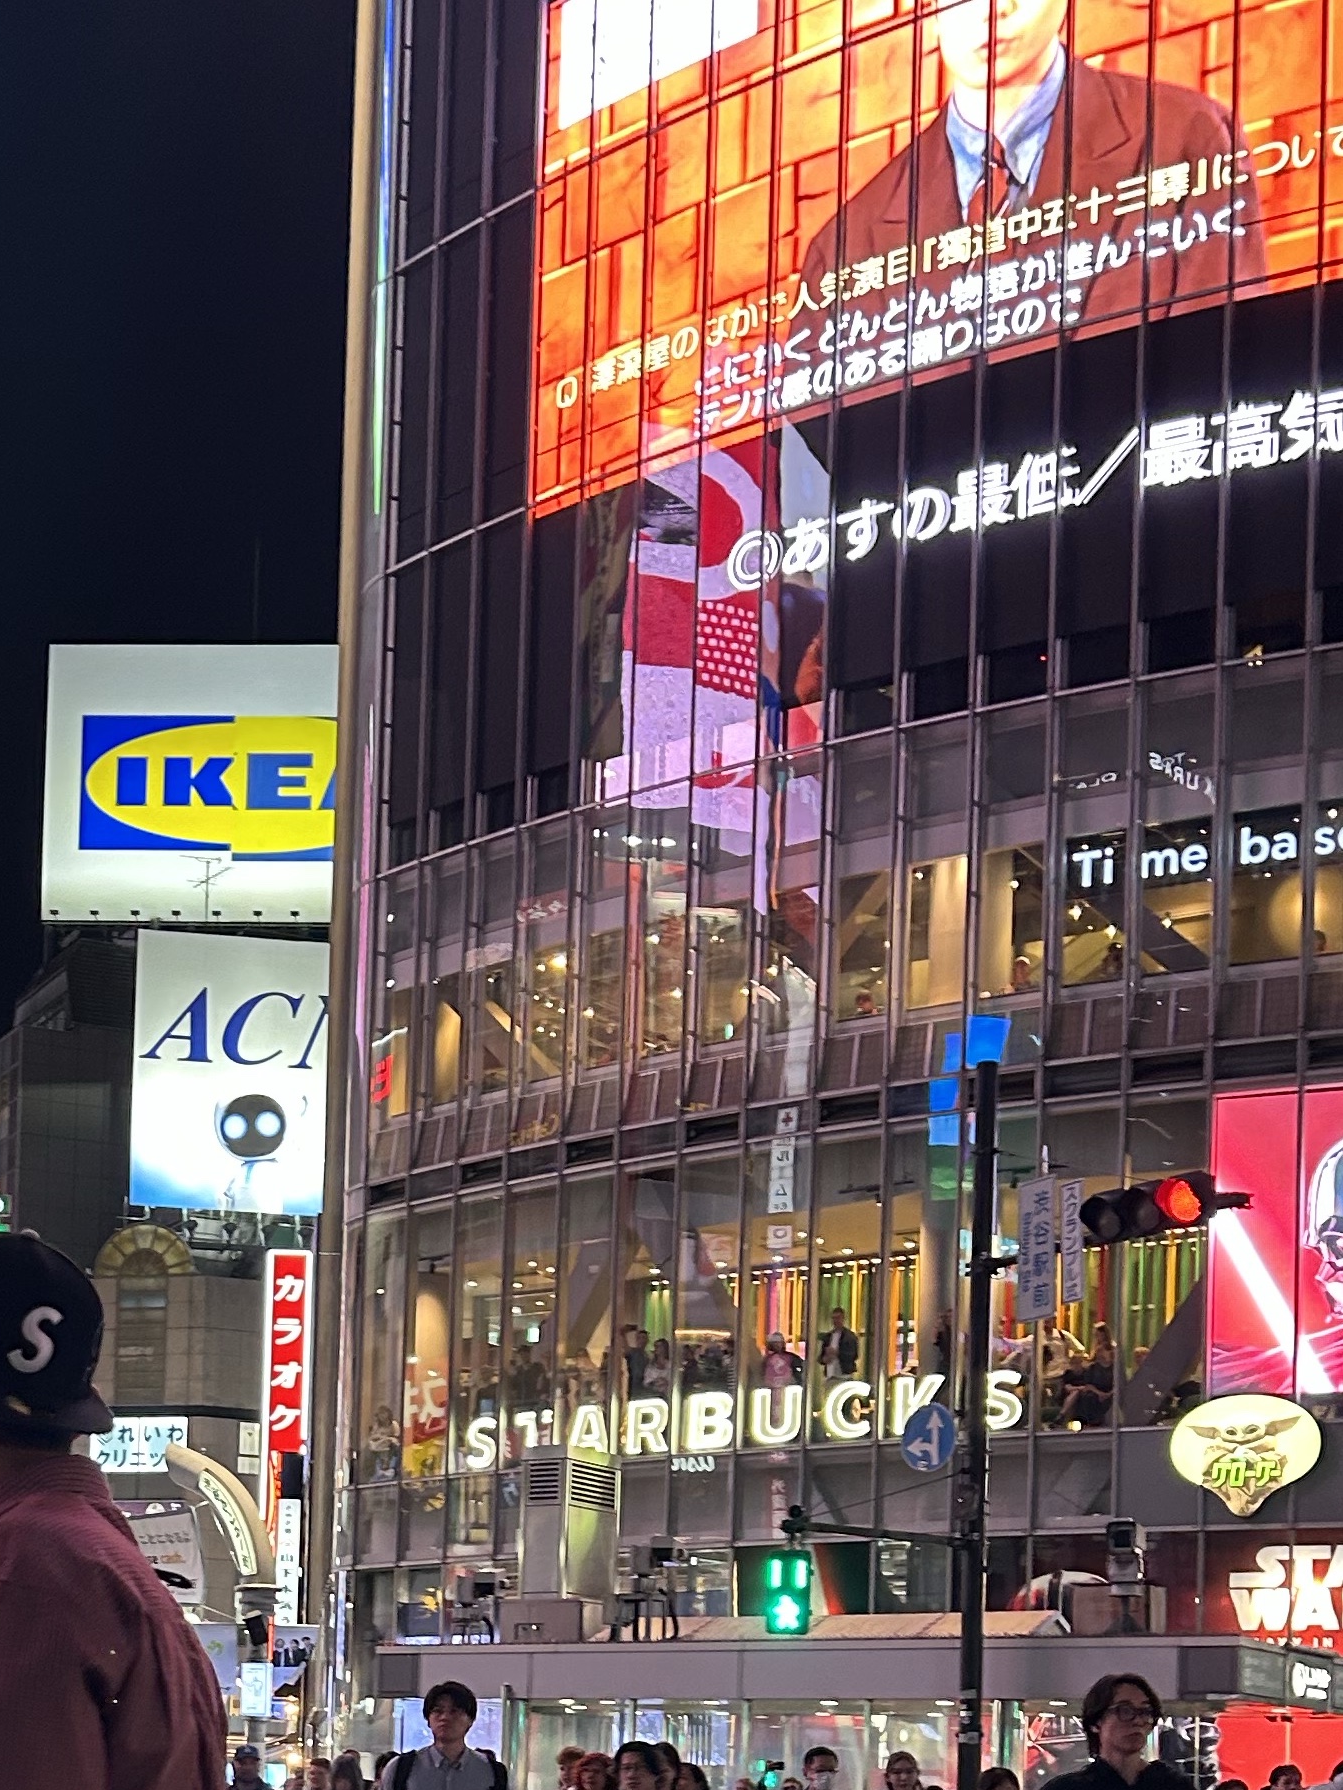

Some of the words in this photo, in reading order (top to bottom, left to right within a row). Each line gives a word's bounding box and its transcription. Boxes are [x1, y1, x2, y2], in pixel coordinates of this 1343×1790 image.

[116, 752, 336, 811] IKE
[1239, 826, 1343, 866] bas
[6, 1306, 65, 1374] S
[268, 1273, 306, 1433] カラオケ
[118, 1424, 184, 1443] れいわ
[96, 1450, 167, 1468] クリニッ
[1212, 1459, 1283, 1489] グローグー
[1230, 1588, 1343, 1631] WA
